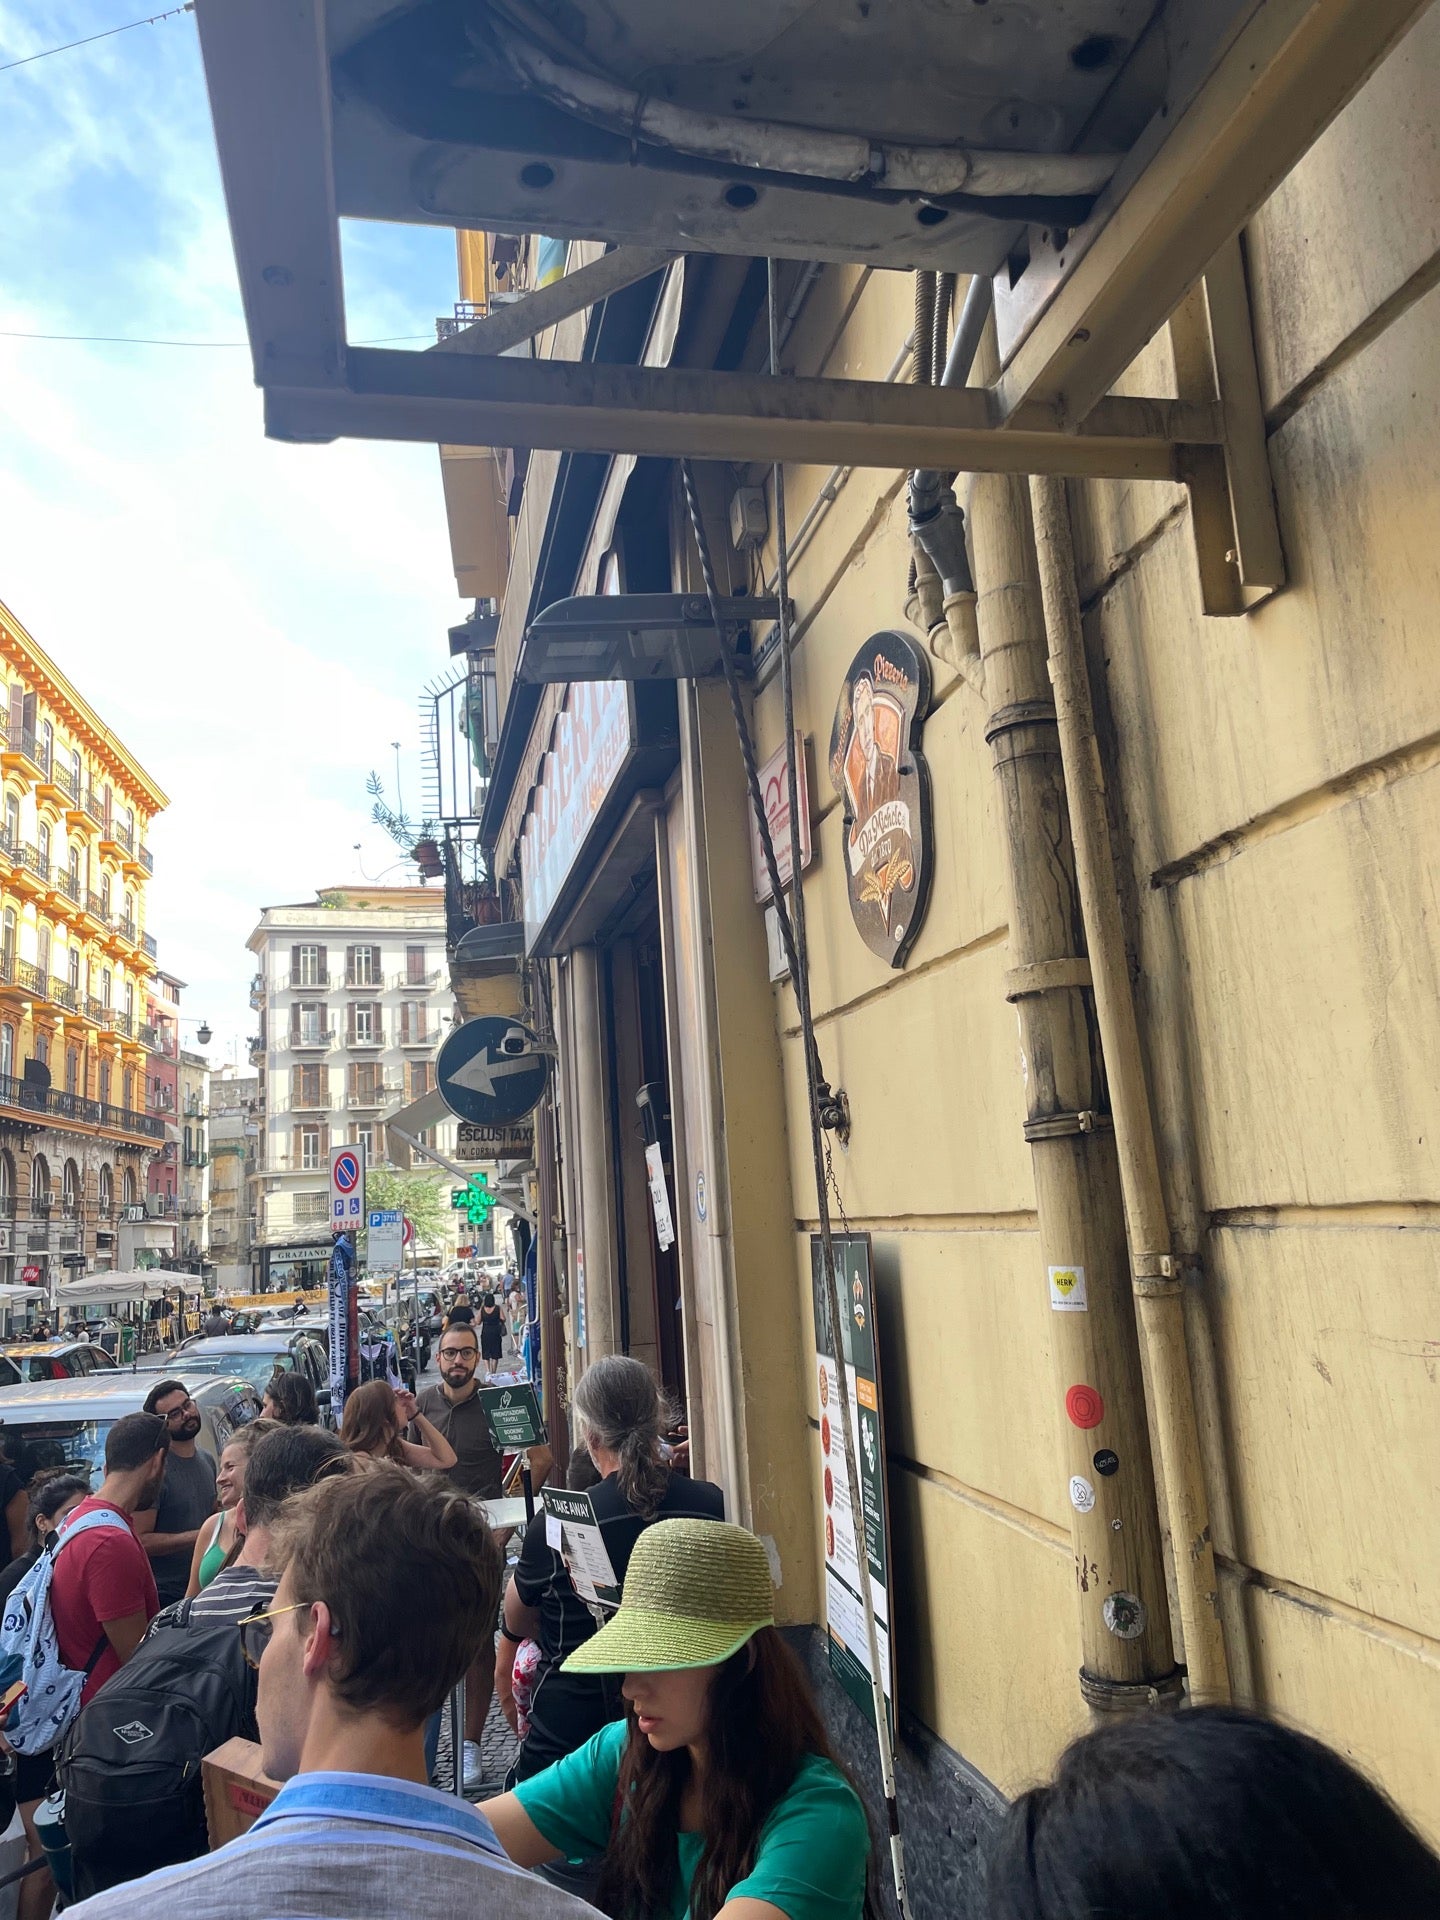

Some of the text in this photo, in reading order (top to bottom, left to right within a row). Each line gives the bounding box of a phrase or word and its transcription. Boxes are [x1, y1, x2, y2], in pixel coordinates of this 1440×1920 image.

[873, 653, 909, 692] Pizzeria
[858, 802, 902, 857] Da Michele
[458, 1128, 506, 1142] ESCLUSI
[458, 1147, 466, 1156] IN
[470, 1147, 496, 1157] CORSIA
[372, 1214, 381, 1226] P
[278, 1249, 328, 1260] GRAZIANO
[23, 1268, 39, 1281] illy
[1056, 1278, 1074, 1287] HERK
[493, 1409, 526, 1418] PRENOTAZIONE
[552, 1498, 590, 1518] TAKE AWAY
